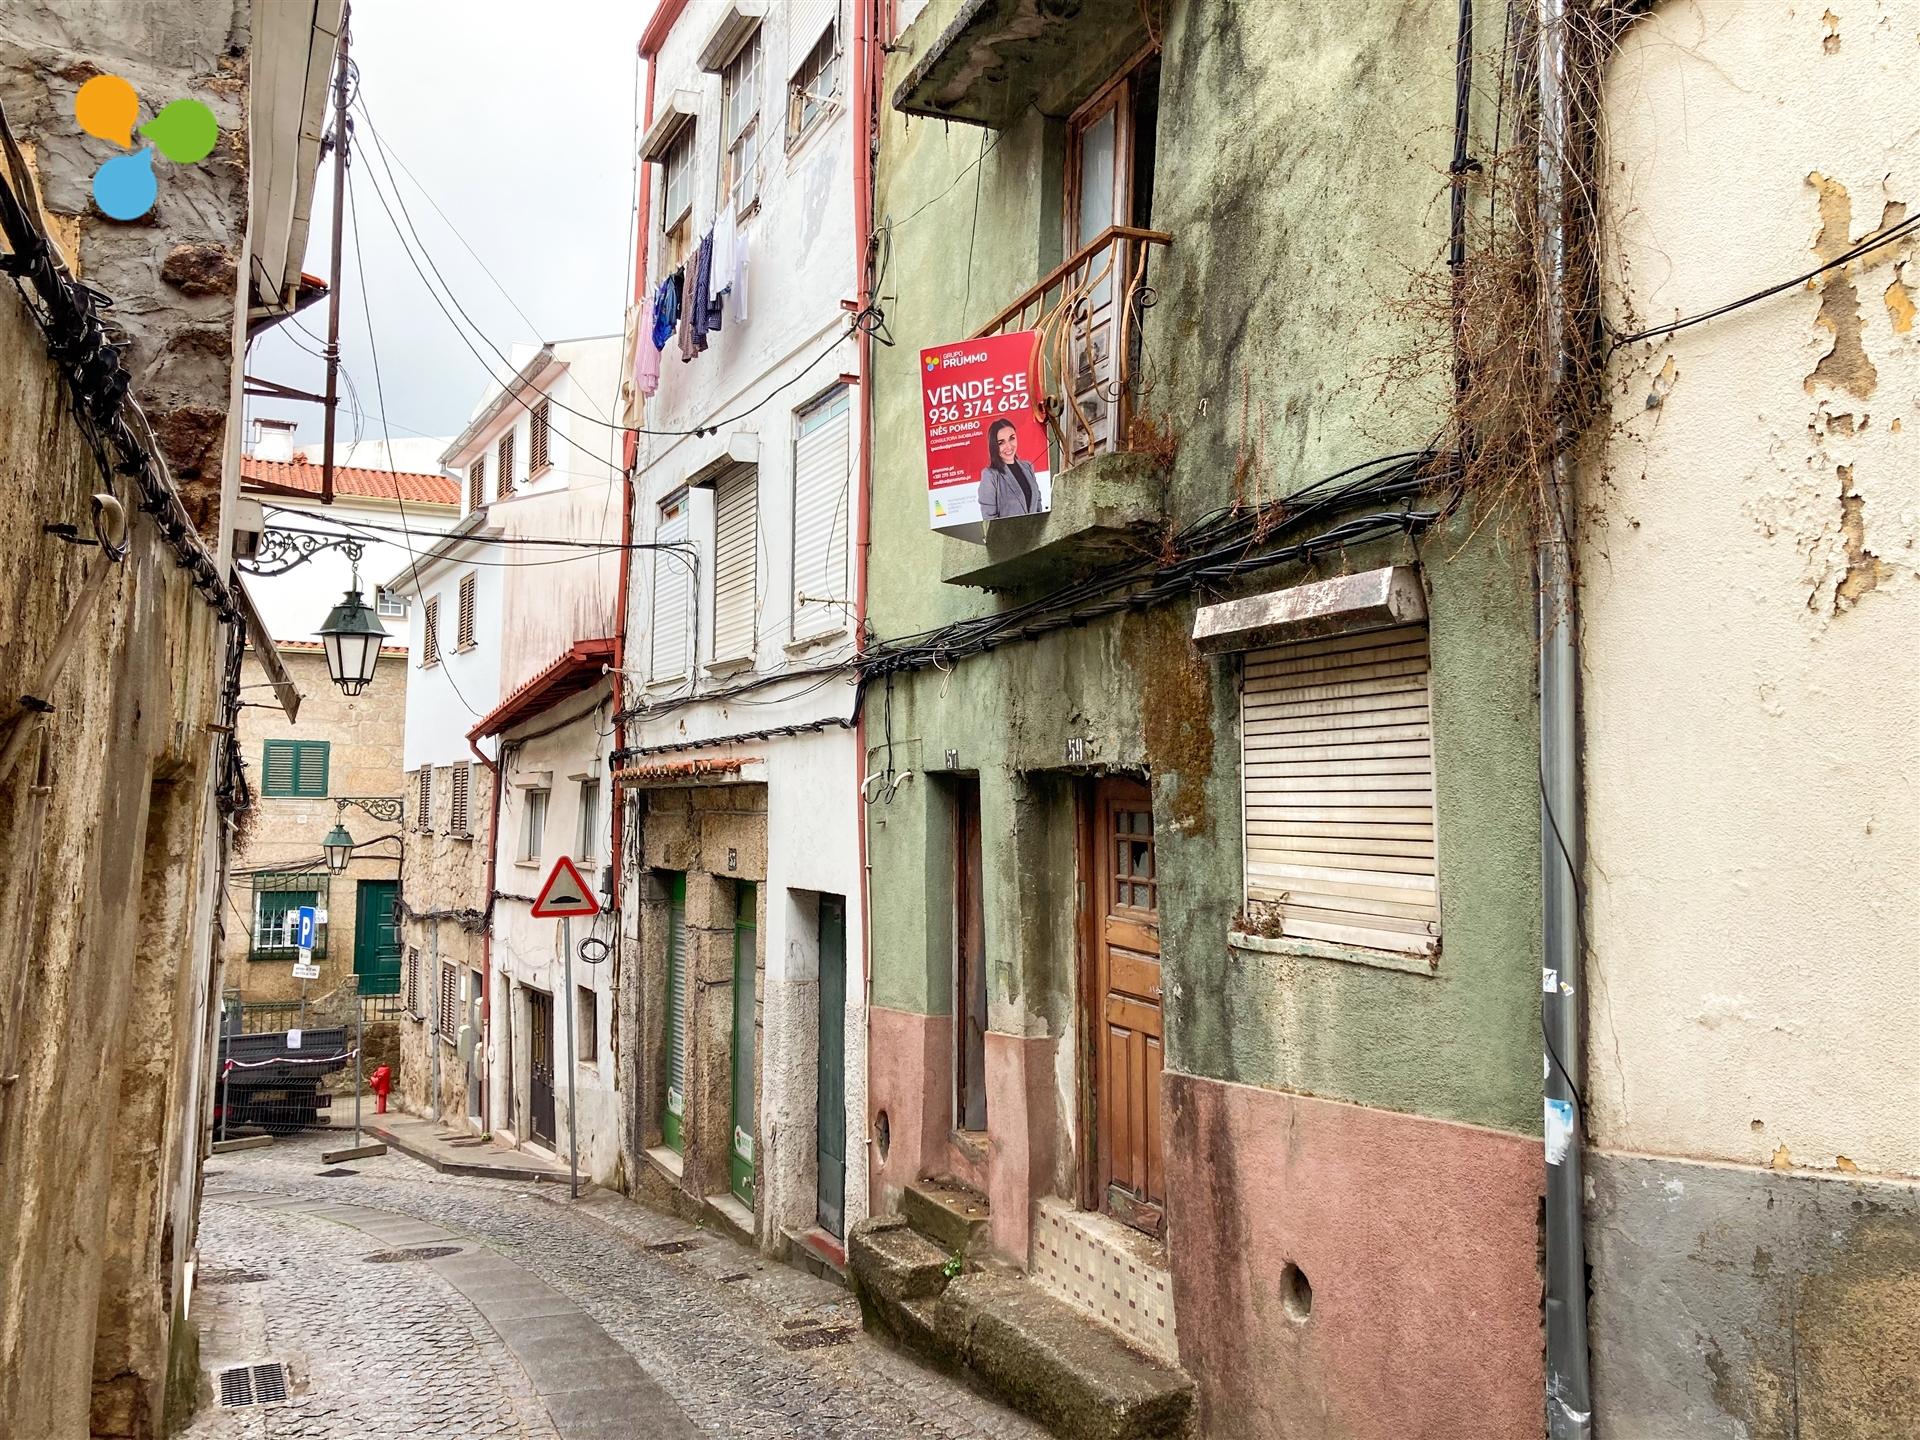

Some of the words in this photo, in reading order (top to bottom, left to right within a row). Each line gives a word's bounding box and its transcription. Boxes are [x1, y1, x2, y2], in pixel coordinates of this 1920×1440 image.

[943, 351, 963, 360] GRUPO
[943, 352, 988, 369] PRUMMO
[927, 372, 1027, 406] VENDE-SE
[929, 404, 959, 425] 936
[963, 398, 993, 418] 374
[998, 392, 1029, 412] 652
[930, 425, 948, 437] INÊS
[949, 421, 981, 434] POMBO
[946, 749, 957, 769] 57
[1067, 738, 1083, 762] 59
[301, 916, 311, 946] P
